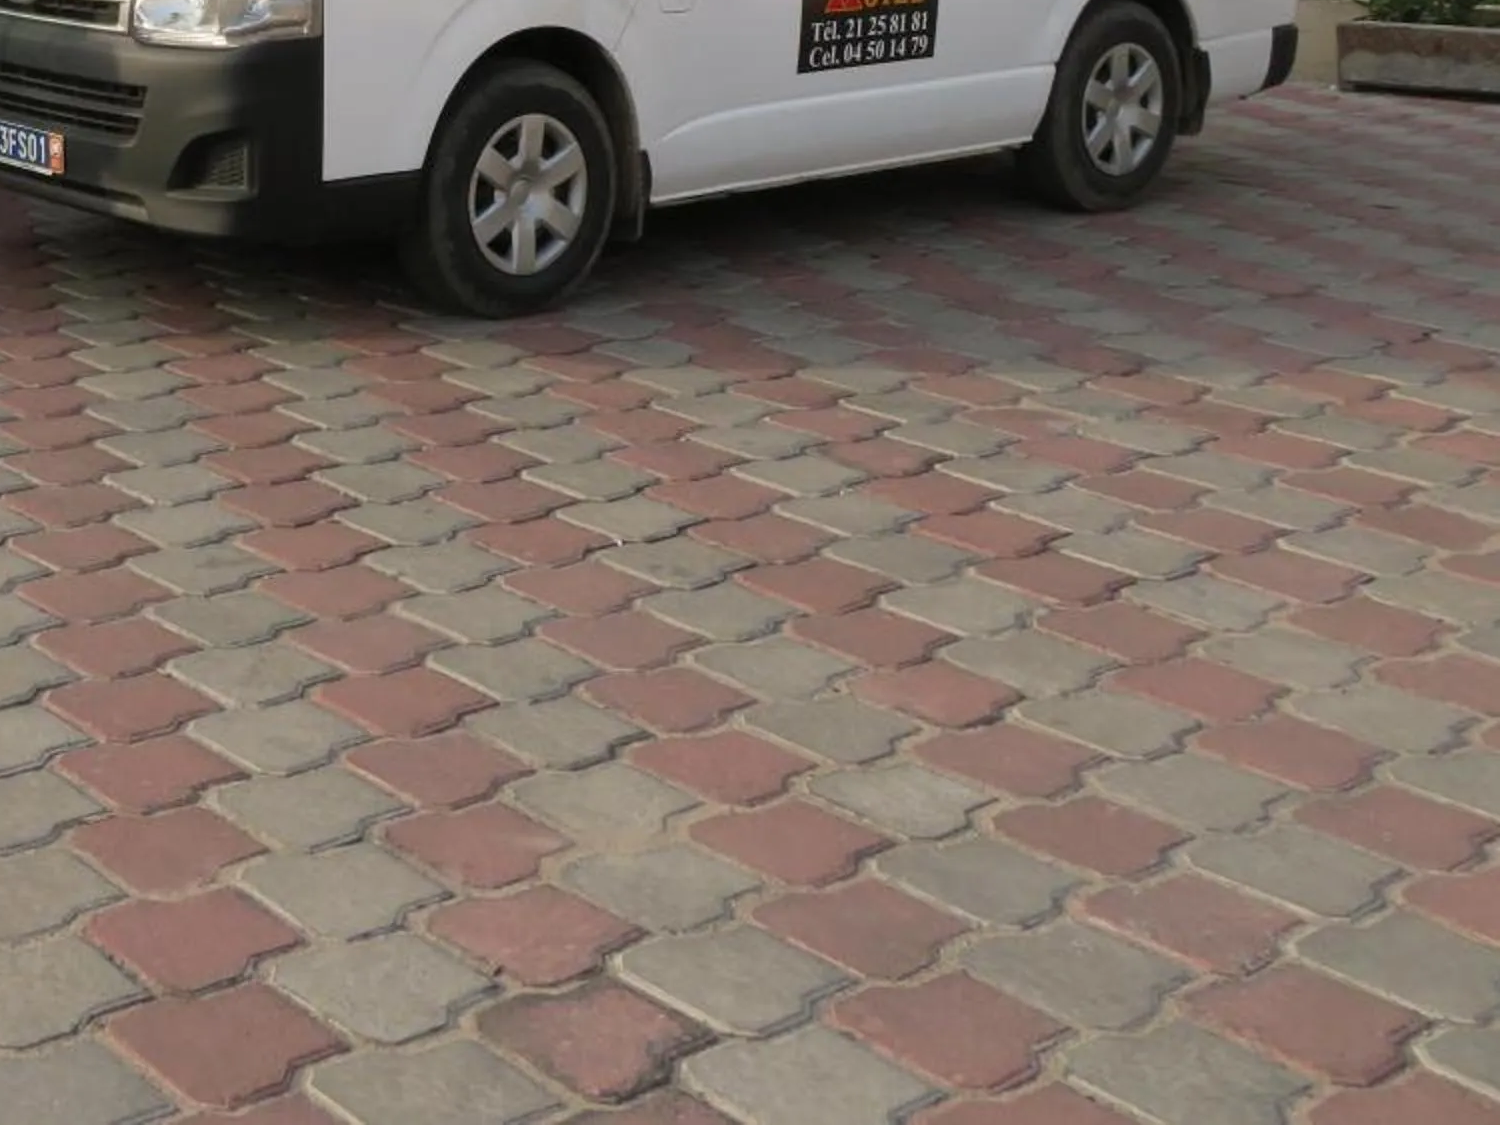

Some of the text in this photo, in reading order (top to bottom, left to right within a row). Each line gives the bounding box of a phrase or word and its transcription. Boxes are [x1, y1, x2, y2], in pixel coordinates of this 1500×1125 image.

[811, 11, 928, 43] Tél. 21 25 81 81
[809, 34, 928, 68] Cel. 04 50 14 79
